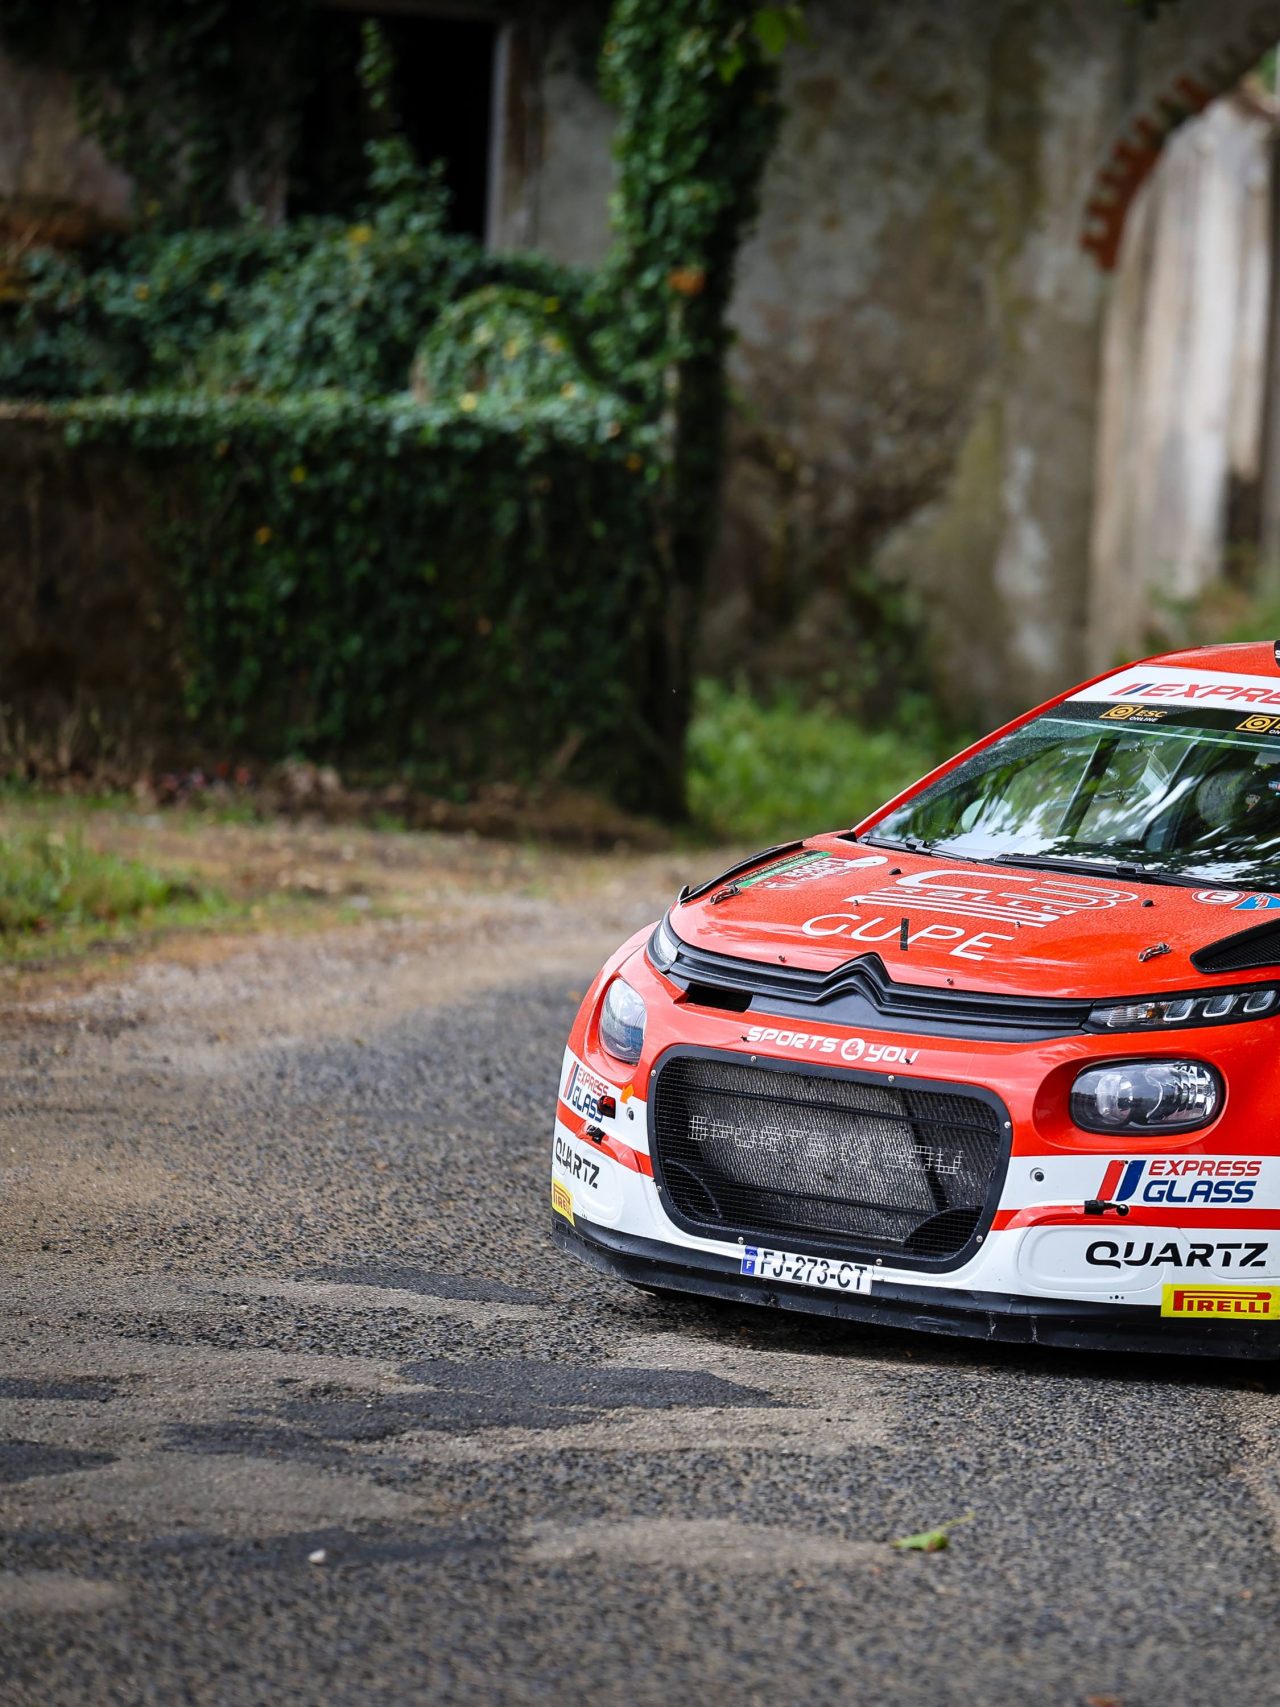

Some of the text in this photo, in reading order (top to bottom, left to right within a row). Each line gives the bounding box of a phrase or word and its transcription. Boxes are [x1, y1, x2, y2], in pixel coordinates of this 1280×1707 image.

[1135, 708, 1168, 718] ESC
[802, 913, 1015, 961] GUPE
[746, 1027, 840, 1053] SPORTS
[864, 1044, 920, 1064] YOU
[577, 1067, 609, 1097] EXPRESS
[556, 1136, 600, 1189] QUARTZ
[1148, 1160, 1262, 1176] EXPRESS
[1143, 1180, 1257, 1204] GLASS
[760, 1250, 868, 1290] FJ-273-CT
[1085, 1241, 1269, 1270] QUARTZ
[1172, 1291, 1272, 1314] PIRELLI
